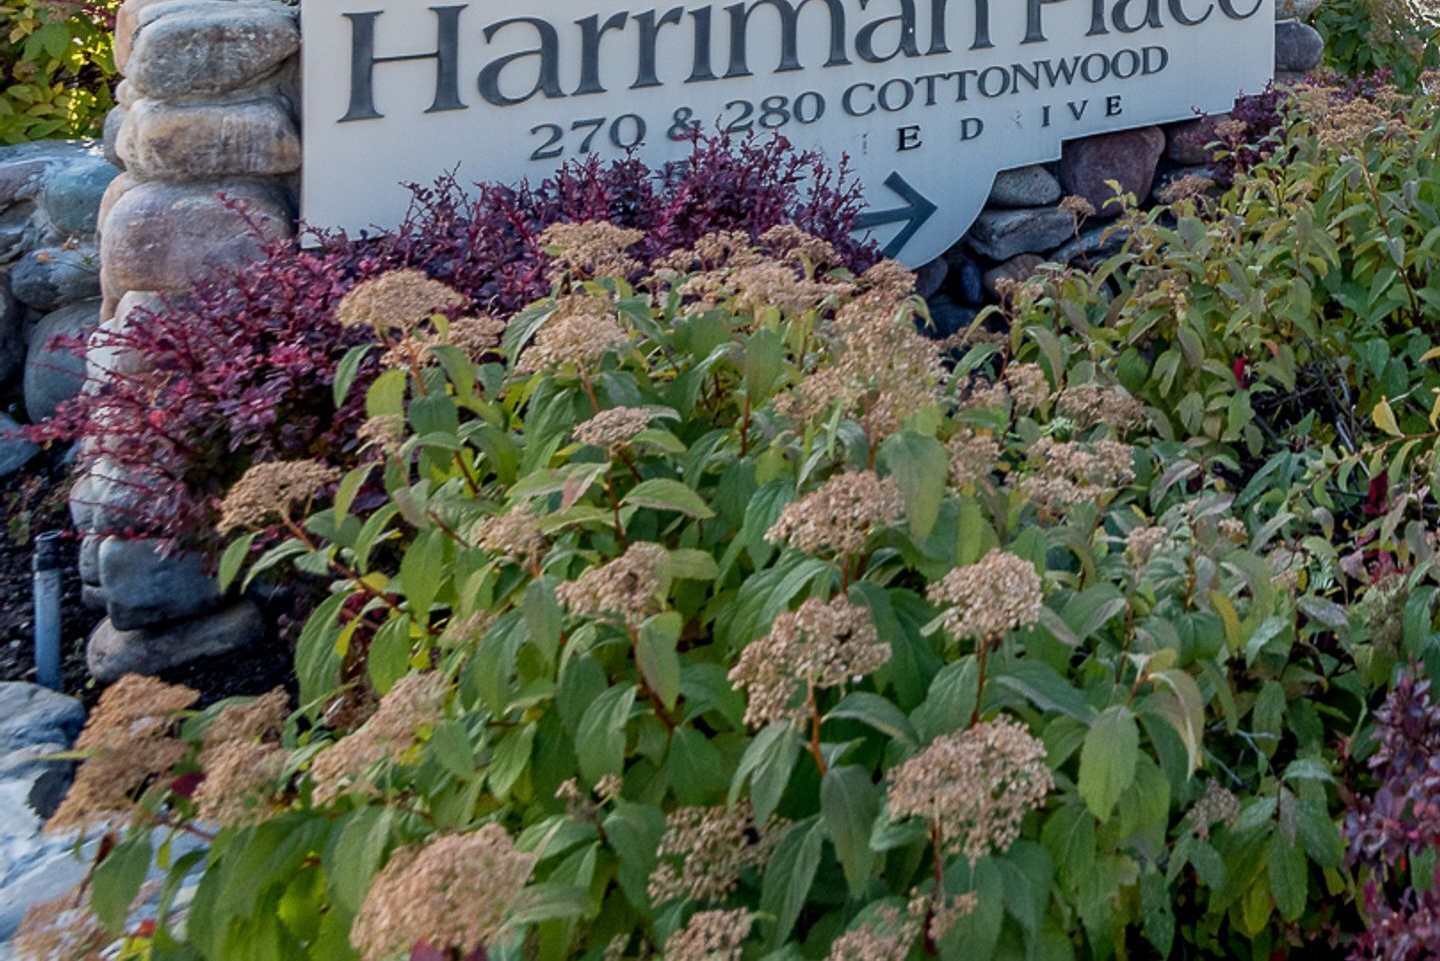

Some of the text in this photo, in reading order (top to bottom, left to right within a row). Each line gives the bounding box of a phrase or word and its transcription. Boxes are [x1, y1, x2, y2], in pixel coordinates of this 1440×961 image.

[529, 113, 647, 162] 270
[666, 106, 702, 142] &
[724, 90, 827, 134] 280
[841, 45, 1169, 117] COTTONWOOD
[959, 94, 1123, 142] DIVE
